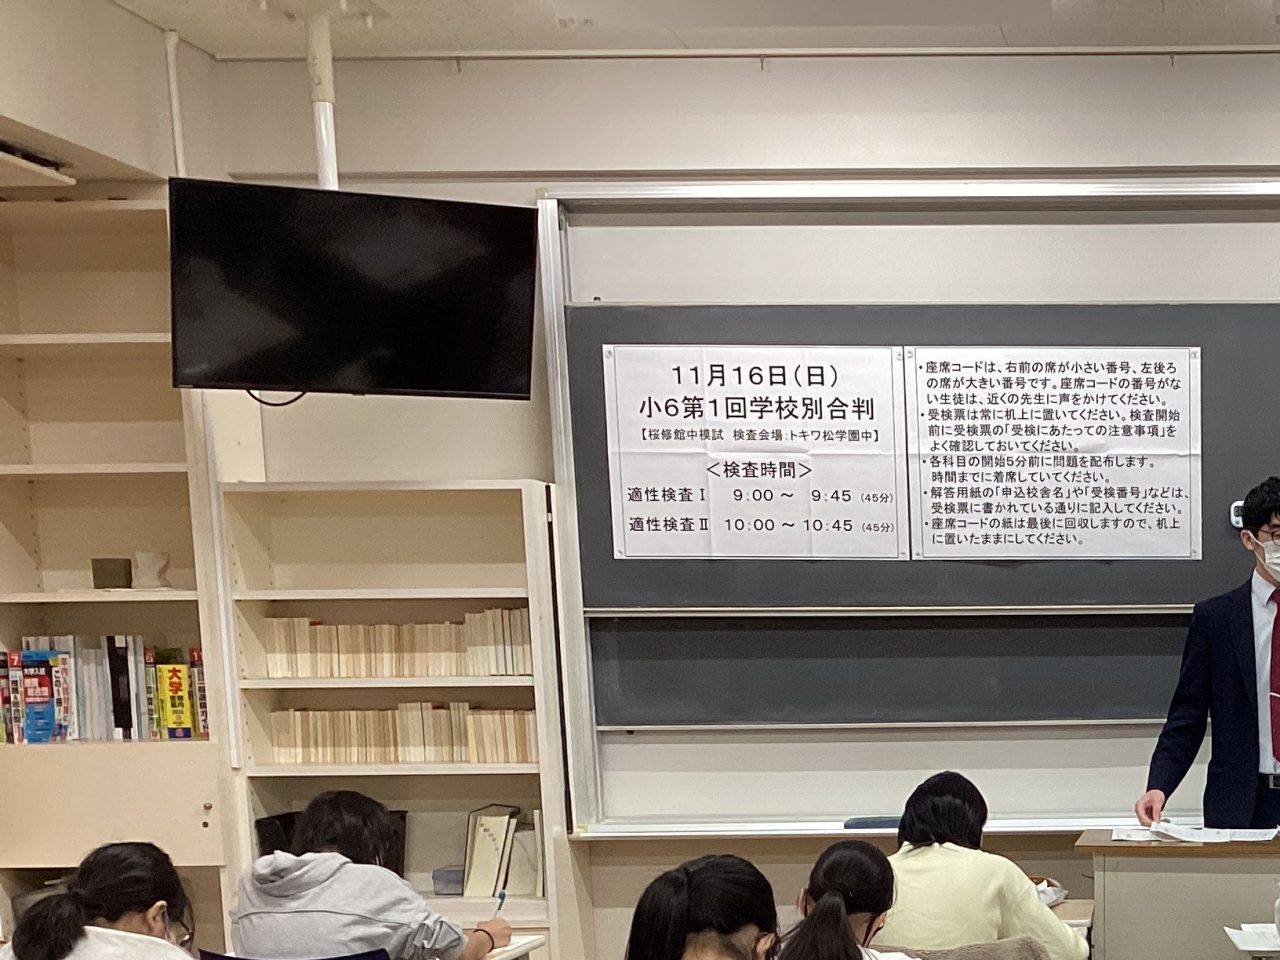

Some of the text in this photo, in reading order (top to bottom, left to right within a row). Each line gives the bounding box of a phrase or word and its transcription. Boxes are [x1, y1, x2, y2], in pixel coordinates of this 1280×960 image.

[671, 363, 839, 388] 11月16日(日)
[639, 396, 875, 421] 小6第1回学校別合判
